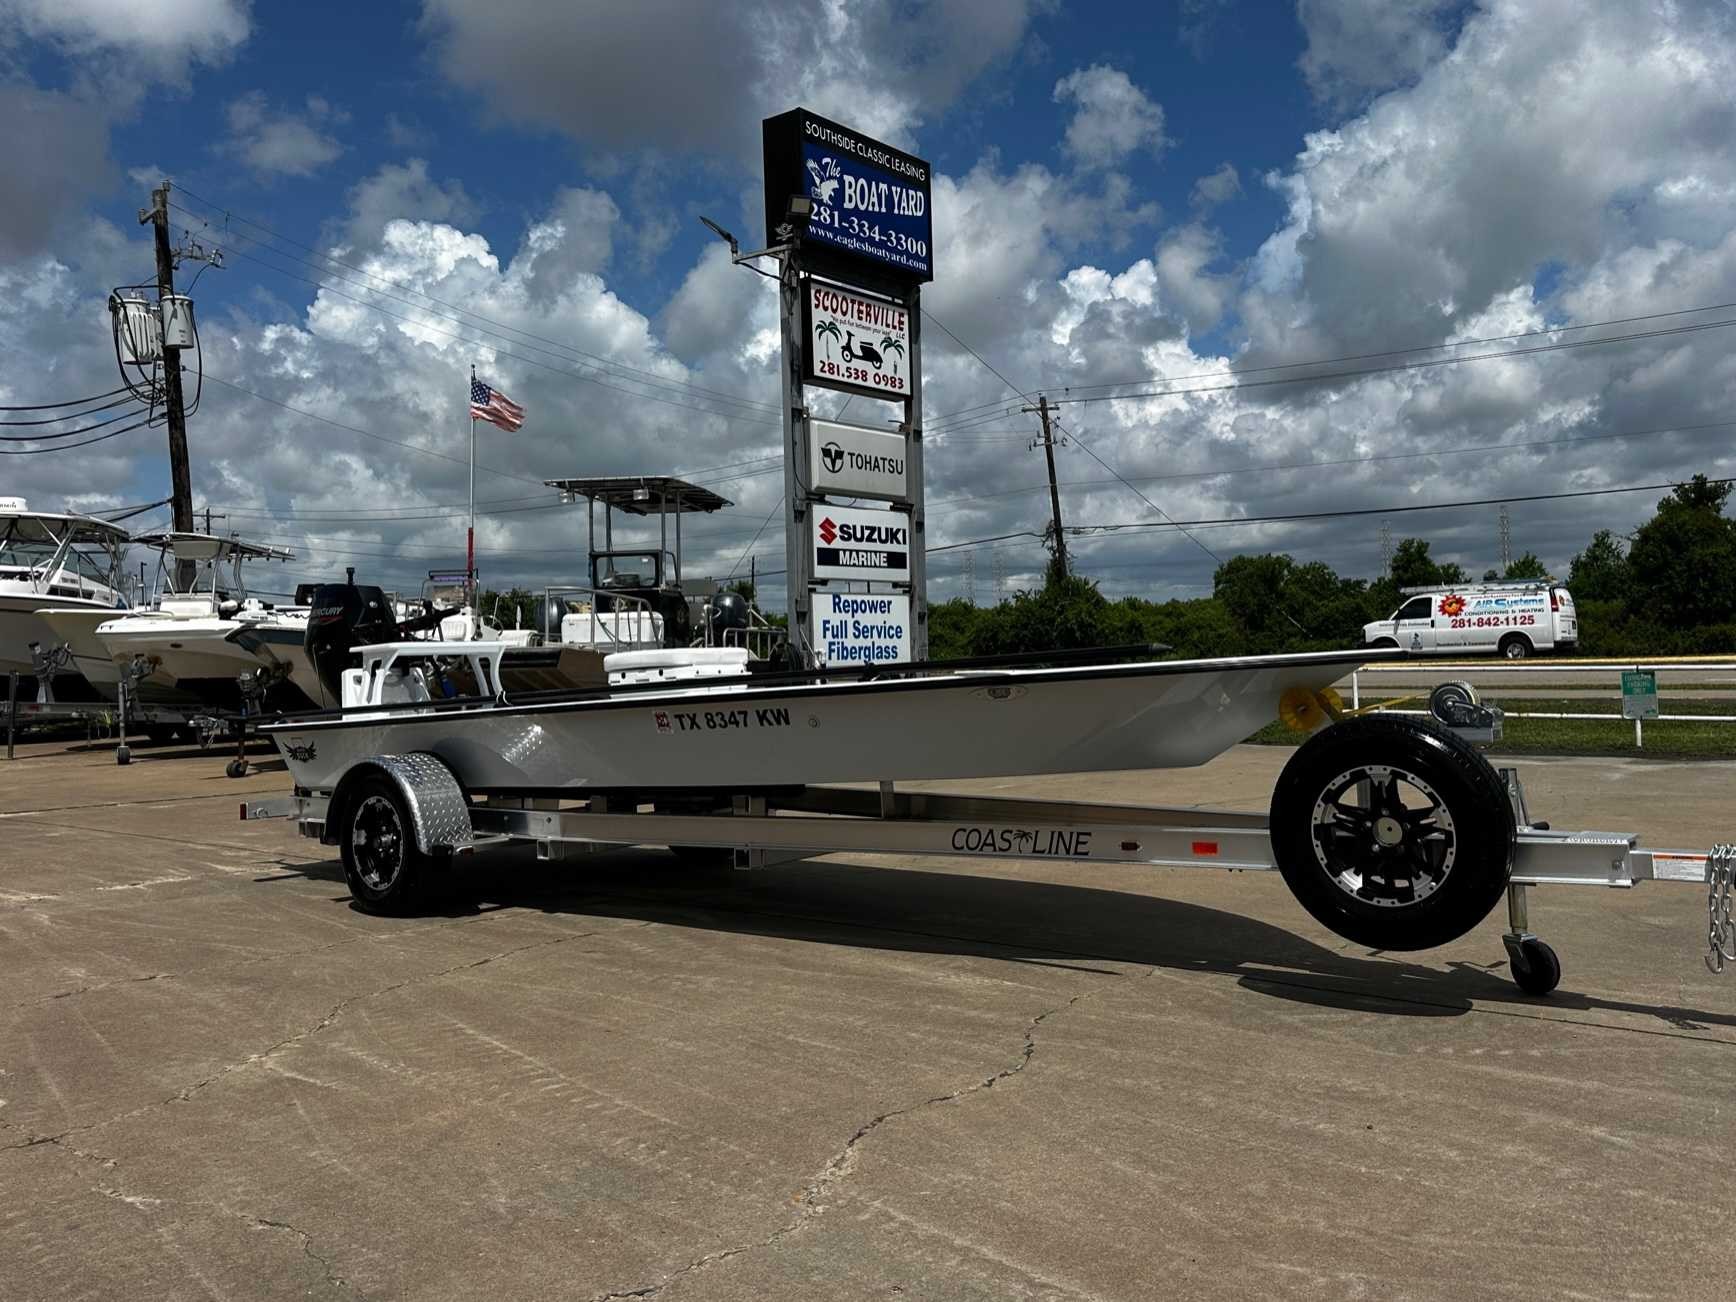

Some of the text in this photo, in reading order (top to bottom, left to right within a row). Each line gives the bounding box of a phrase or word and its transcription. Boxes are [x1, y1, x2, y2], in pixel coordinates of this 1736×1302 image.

[805, 121, 926, 182] SOUTHSIDE CLASSIC LEASING
[822, 157, 841, 178] The
[843, 174, 925, 217] BOAT YARD
[810, 202, 927, 258] 281-334-3300
[808, 224, 927, 271] www.eaglesboatyard.com
[814, 288, 905, 331] SCOOTERVILLE
[820, 360, 904, 389] 281.538 0983
[848, 452, 903, 475] TOHATSU
[839, 523, 907, 545] SUZUKI
[839, 550, 888, 567] MARINE
[832, 594, 892, 618] Repower
[822, 620, 903, 640] Full Service
[828, 641, 899, 662] Fiberglass
[674, 713, 701, 731] TX
[704, 710, 749, 730] 8347
[755, 708, 791, 727] KW
